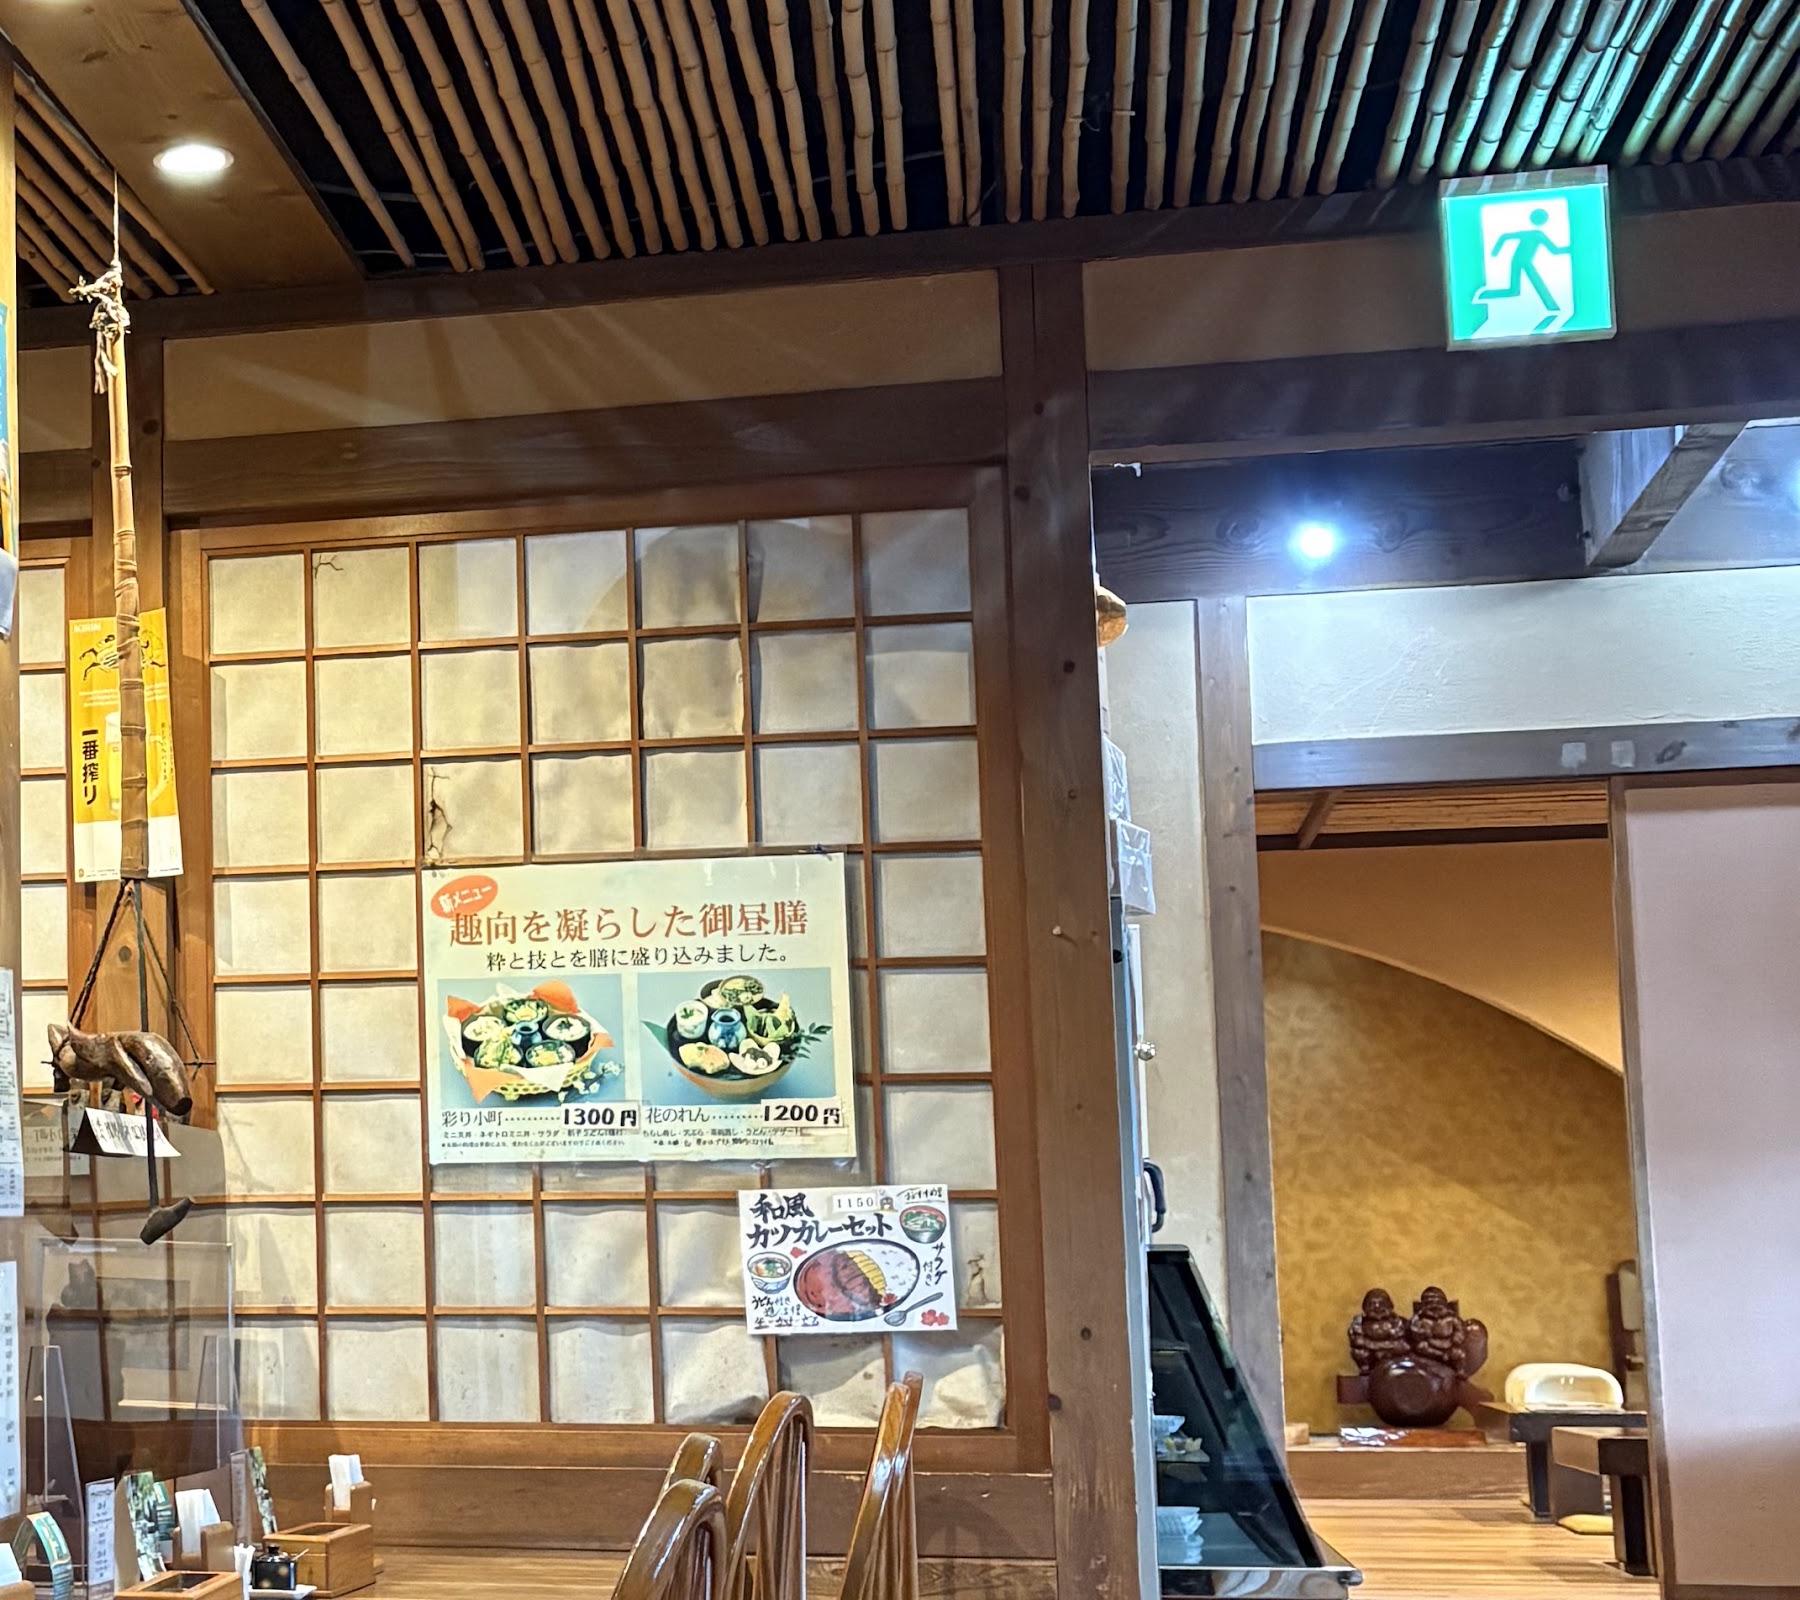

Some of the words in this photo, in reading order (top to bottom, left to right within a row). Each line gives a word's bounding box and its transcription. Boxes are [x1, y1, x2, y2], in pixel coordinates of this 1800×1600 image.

[82, 729, 99, 805] 一番搾り
[439, 885, 492, 913] 新メニュー
[451, 900, 808, 947] 趣向を凝らした御昼膳
[486, 943, 787, 972] 粋と技とを膳に盛り込みました。
[441, 1110, 504, 1128] 彩り小町
[645, 1107, 710, 1124] 花のれん
[750, 1192, 815, 1223] 和風
[746, 1213, 893, 1249] カツカレーセット
[931, 1241, 948, 1285] サラダ
